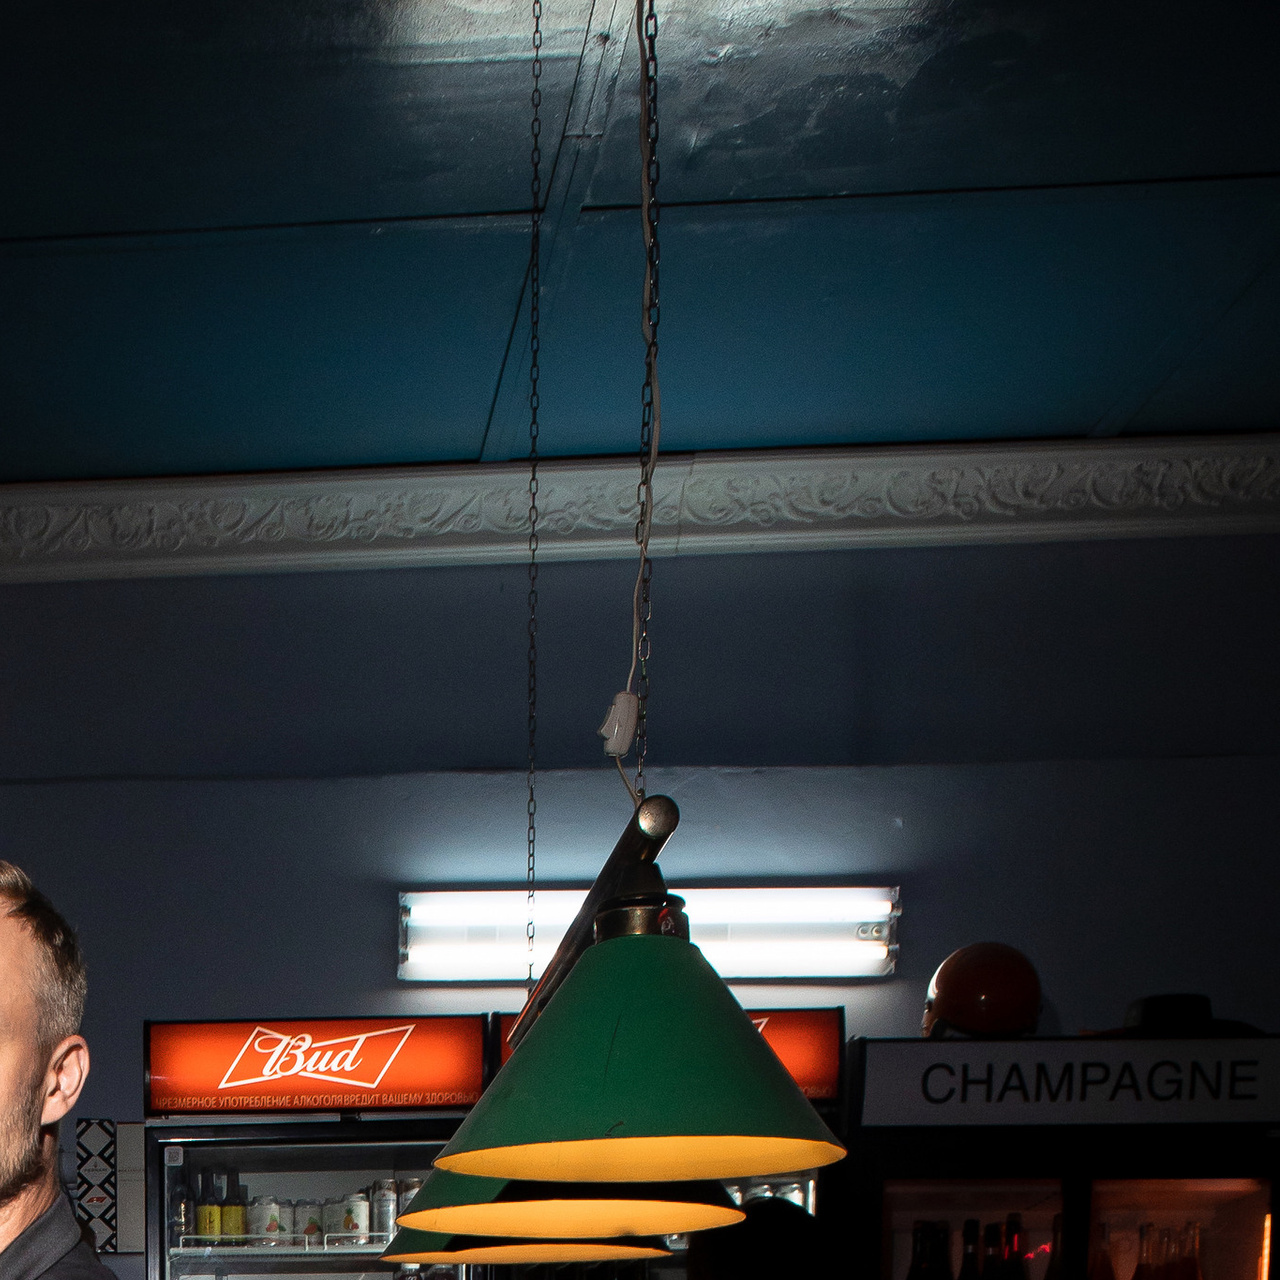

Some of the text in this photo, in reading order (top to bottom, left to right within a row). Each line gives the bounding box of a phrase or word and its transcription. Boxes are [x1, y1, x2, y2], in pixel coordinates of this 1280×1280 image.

[254, 1033, 363, 1077] Bud
[155, 1092, 478, 1109] ЧРЕЗМЕРНОЕ УПОТРЕБЛЕНИЕ АЛКОГОЛЯ ВРЕДИТ ВАШЕМУ ЗДОРОВЬЮ
[921, 1060, 1259, 1104] CHAMPAGNE
